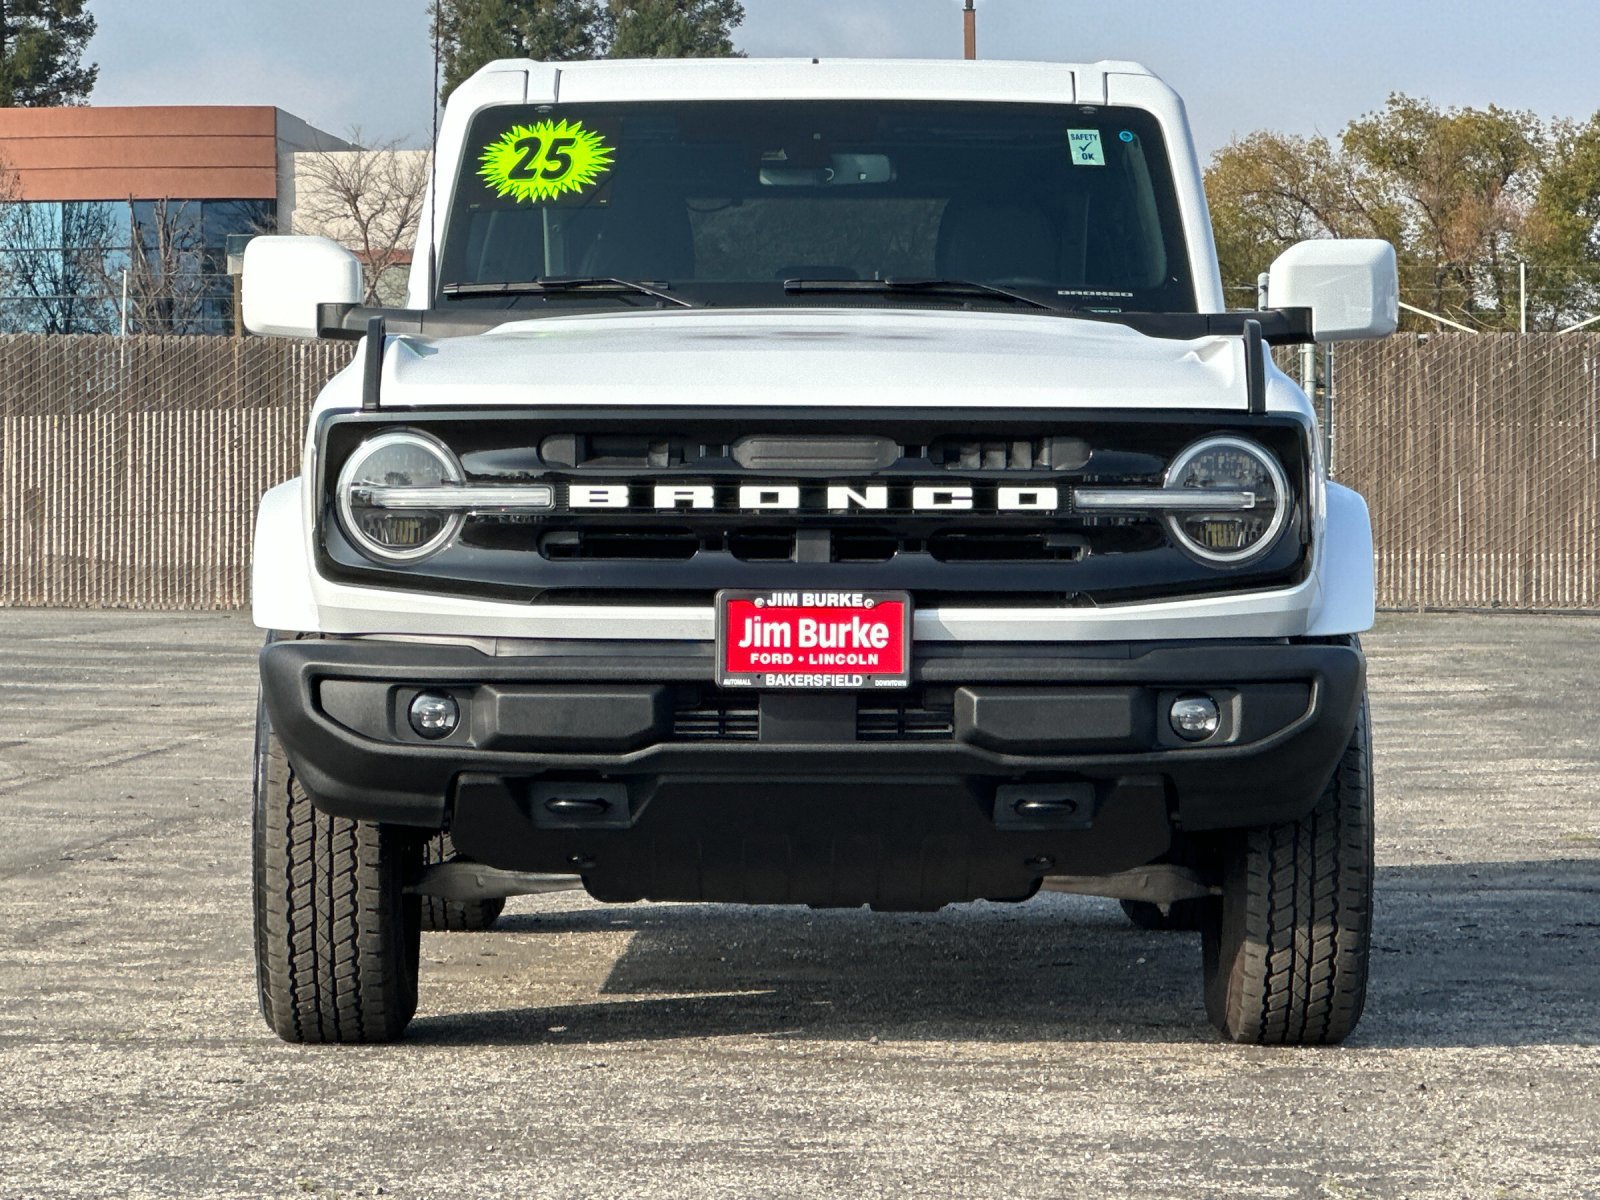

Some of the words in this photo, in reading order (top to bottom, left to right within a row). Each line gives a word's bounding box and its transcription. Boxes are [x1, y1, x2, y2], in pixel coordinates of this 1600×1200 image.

[1070, 133, 1098, 141] SAFETY
[508, 137, 577, 181] 25
[1081, 152, 1095, 160] OK
[568, 484, 1058, 510] BRONCO
[767, 593, 798, 607] JIM
[802, 593, 863, 608] BURKE
[738, 616, 791, 648] Jim
[799, 616, 889, 649] Burke
[750, 653, 794, 665] FORD
[808, 653, 879, 665] LINCOLN
[723, 678, 752, 686] AUTOMALL
[765, 674, 863, 686] BAKERSFIELD
[875, 679, 907, 687] DOWNTOWN
